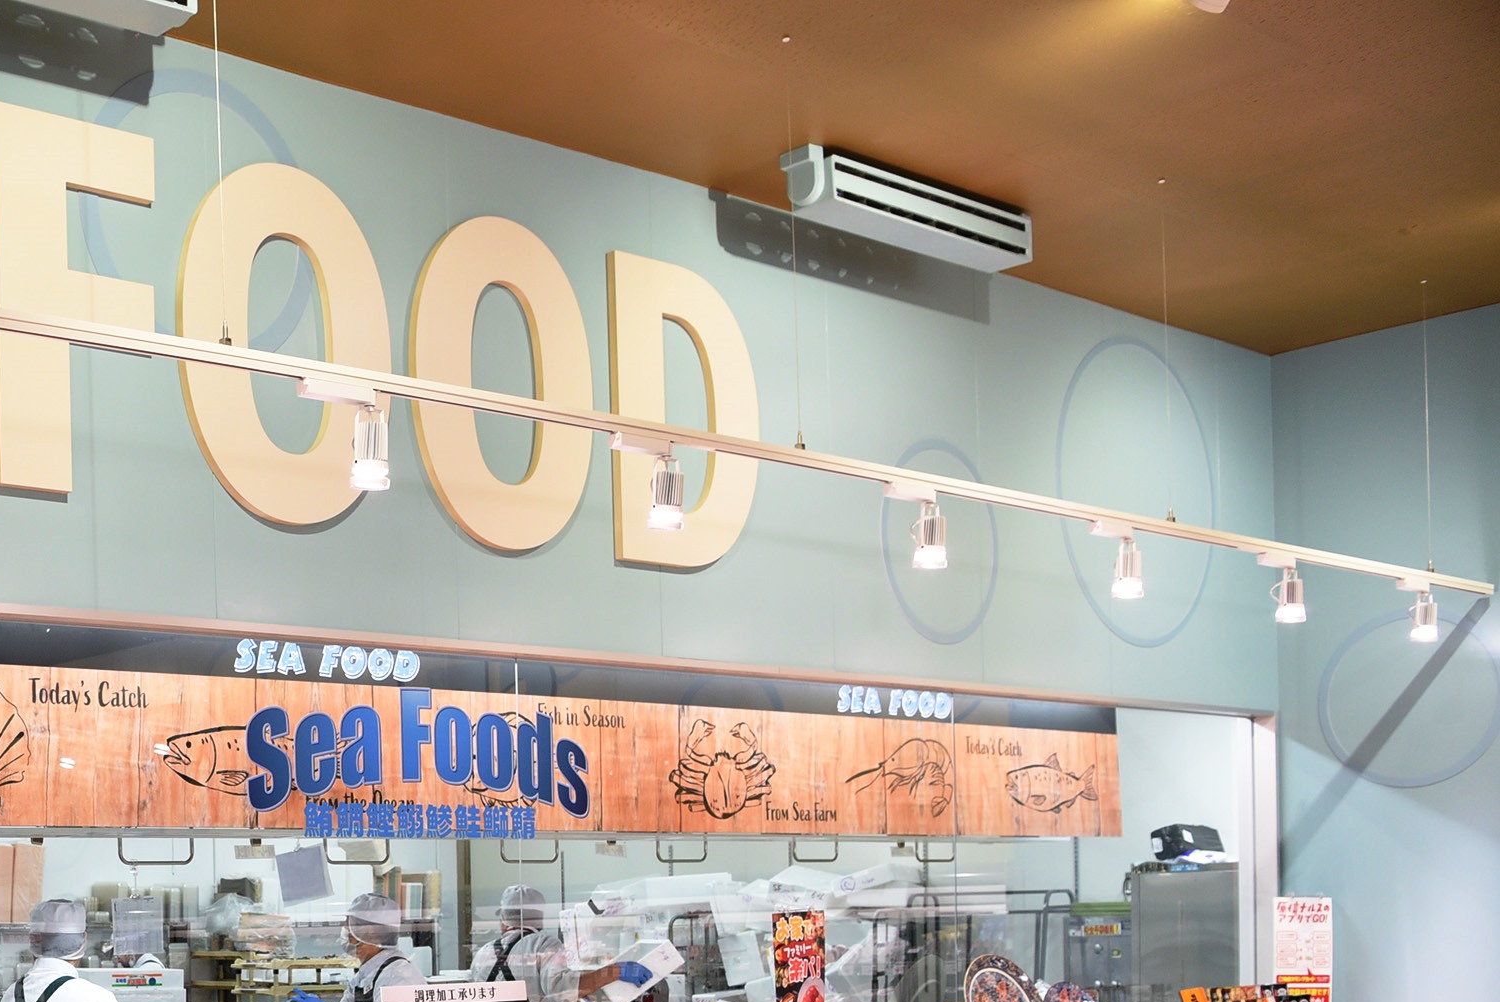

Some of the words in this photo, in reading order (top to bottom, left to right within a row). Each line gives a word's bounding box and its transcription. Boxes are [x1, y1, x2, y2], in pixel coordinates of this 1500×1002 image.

[235, 639, 307, 674] SEA
[320, 644, 421, 682] FOOD
[29, 677, 91, 713] Today's
[98, 682, 149, 710] Catch
[837, 686, 881, 714] SEA
[889, 689, 952, 719] FOOD
[566, 708, 579, 727] in
[582, 700, 626, 730] Season
[246, 705, 382, 812] Sea
[400, 687, 590, 819] Foods
[966, 736, 996, 757] Today's
[998, 737, 1022, 757] Catch
[765, 800, 789, 822] From
[792, 801, 811, 823] Sea
[814, 803, 838, 824] Farm
[414, 986, 497, 1002] 調理加工承ります
